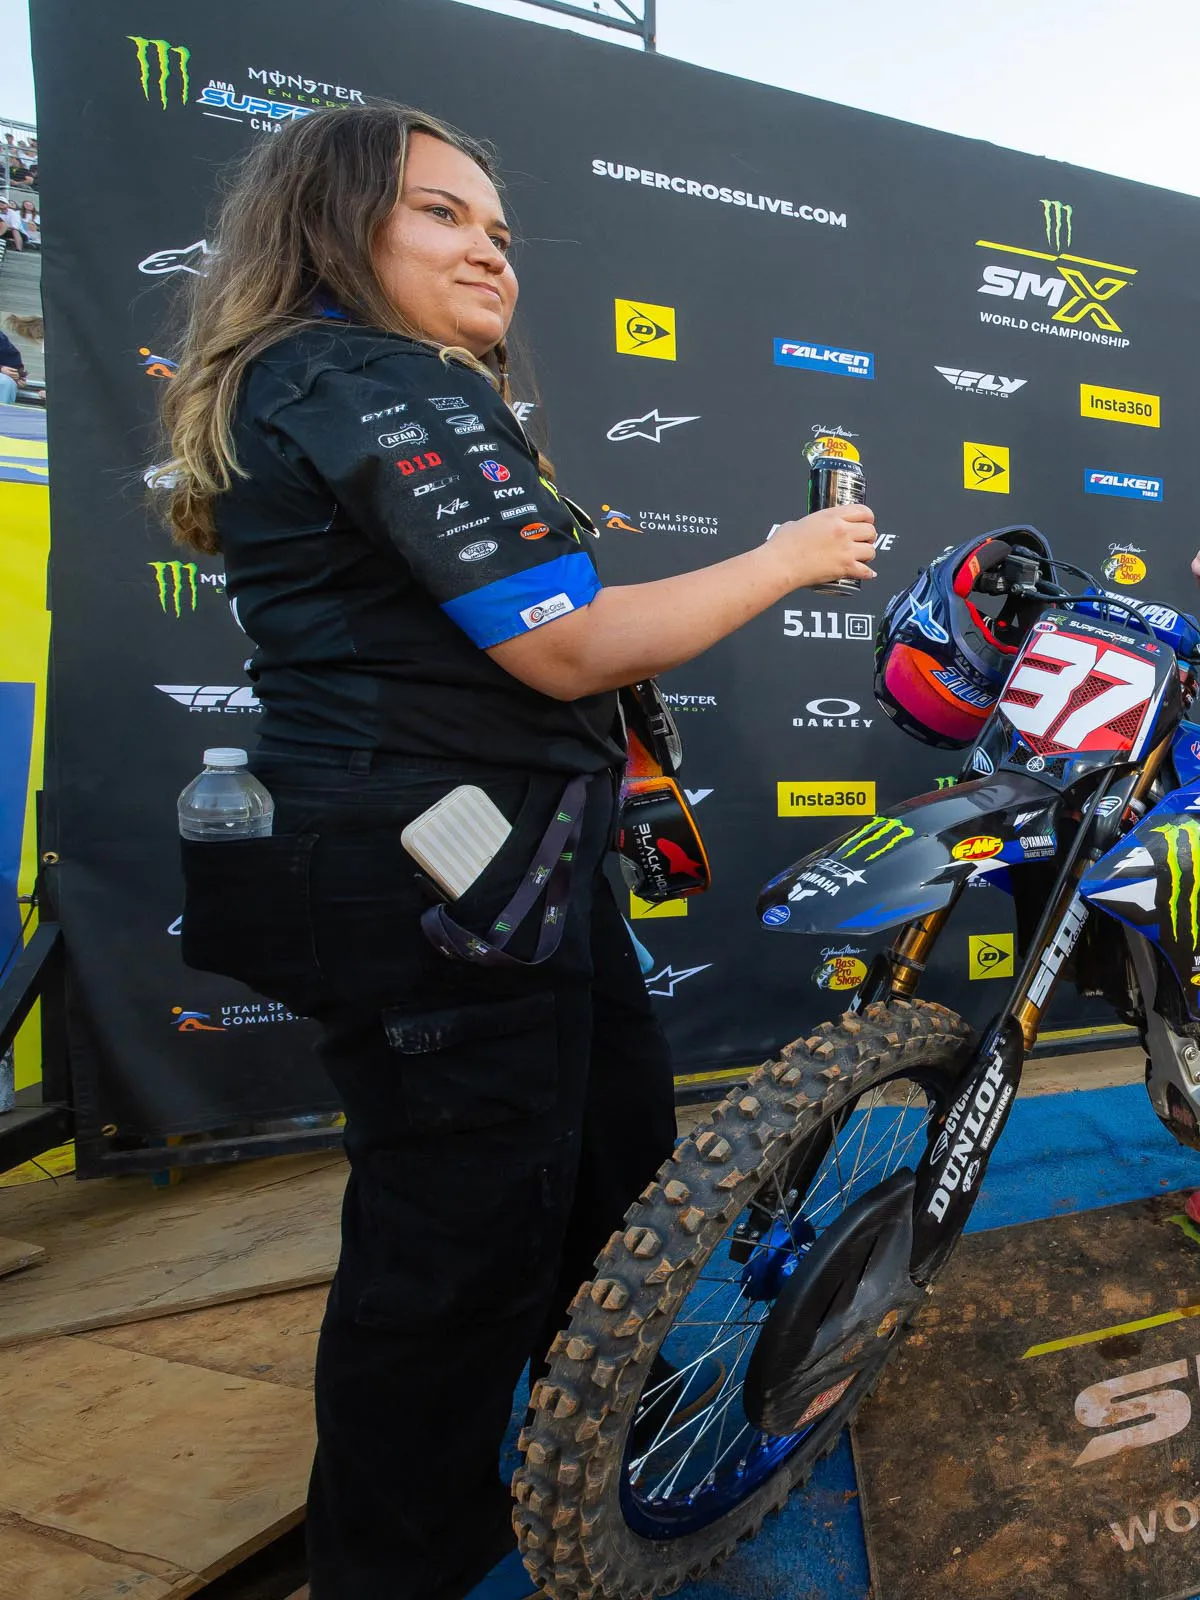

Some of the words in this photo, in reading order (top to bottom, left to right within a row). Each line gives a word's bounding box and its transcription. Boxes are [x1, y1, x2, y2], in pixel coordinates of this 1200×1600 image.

[208, 79, 235, 92] AMA
[247, 67, 366, 105] MONSTER
[267, 88, 351, 109] ENERGY
[591, 158, 848, 229] SUPERCROSSLIVE.COM
[976, 265, 1129, 333] SMX
[979, 311, 1029, 330] WORLD
[1031, 320, 1131, 349] CHAMPIONSHIP
[780, 343, 870, 367] FALKEN
[847, 366, 868, 375] TIRES
[942, 366, 1028, 394] FLY
[954, 385, 1010, 399] RACING
[1089, 394, 1153, 418] Insta360
[386, 430, 418, 444] AFAM
[826, 438, 848, 451] Bass
[464, 443, 497, 455] ARC
[827, 449, 844, 458] Pro
[396, 451, 443, 477] DID
[1090, 473, 1160, 492] FALKEN
[446, 516, 491, 537] DUNLOP
[639, 511, 671, 522] UTAH
[675, 513, 719, 527] SPORTS
[639, 521, 719, 536] COMMISSION
[1120, 554, 1137, 565] Bass
[1120, 563, 1134, 572] Pro
[1120, 570, 1142, 582] Shops
[782, 609, 843, 640] 5.11
[1068, 620, 1136, 645] SUPERCROSS
[999, 631, 1157, 750] 37
[189, 706, 262, 714] RACIN
[792, 717, 875, 729] OAKLEY
[789, 791, 867, 807] Insta360
[953, 838, 1002, 860] FMF
[1026, 834, 1054, 848] YAMAHA
[638, 822, 663, 873] BLACK
[654, 873, 669, 893] HOL
[834, 958, 856, 969] Bass
[834, 967, 852, 977] Pro
[834, 974, 862, 986] Shops
[220, 1003, 261, 1015] UTAH
[222, 1012, 296, 1026] COMMISS
[980, 1083, 1013, 1151] BRAKING
[927, 1054, 1005, 1224] DUNLOP
